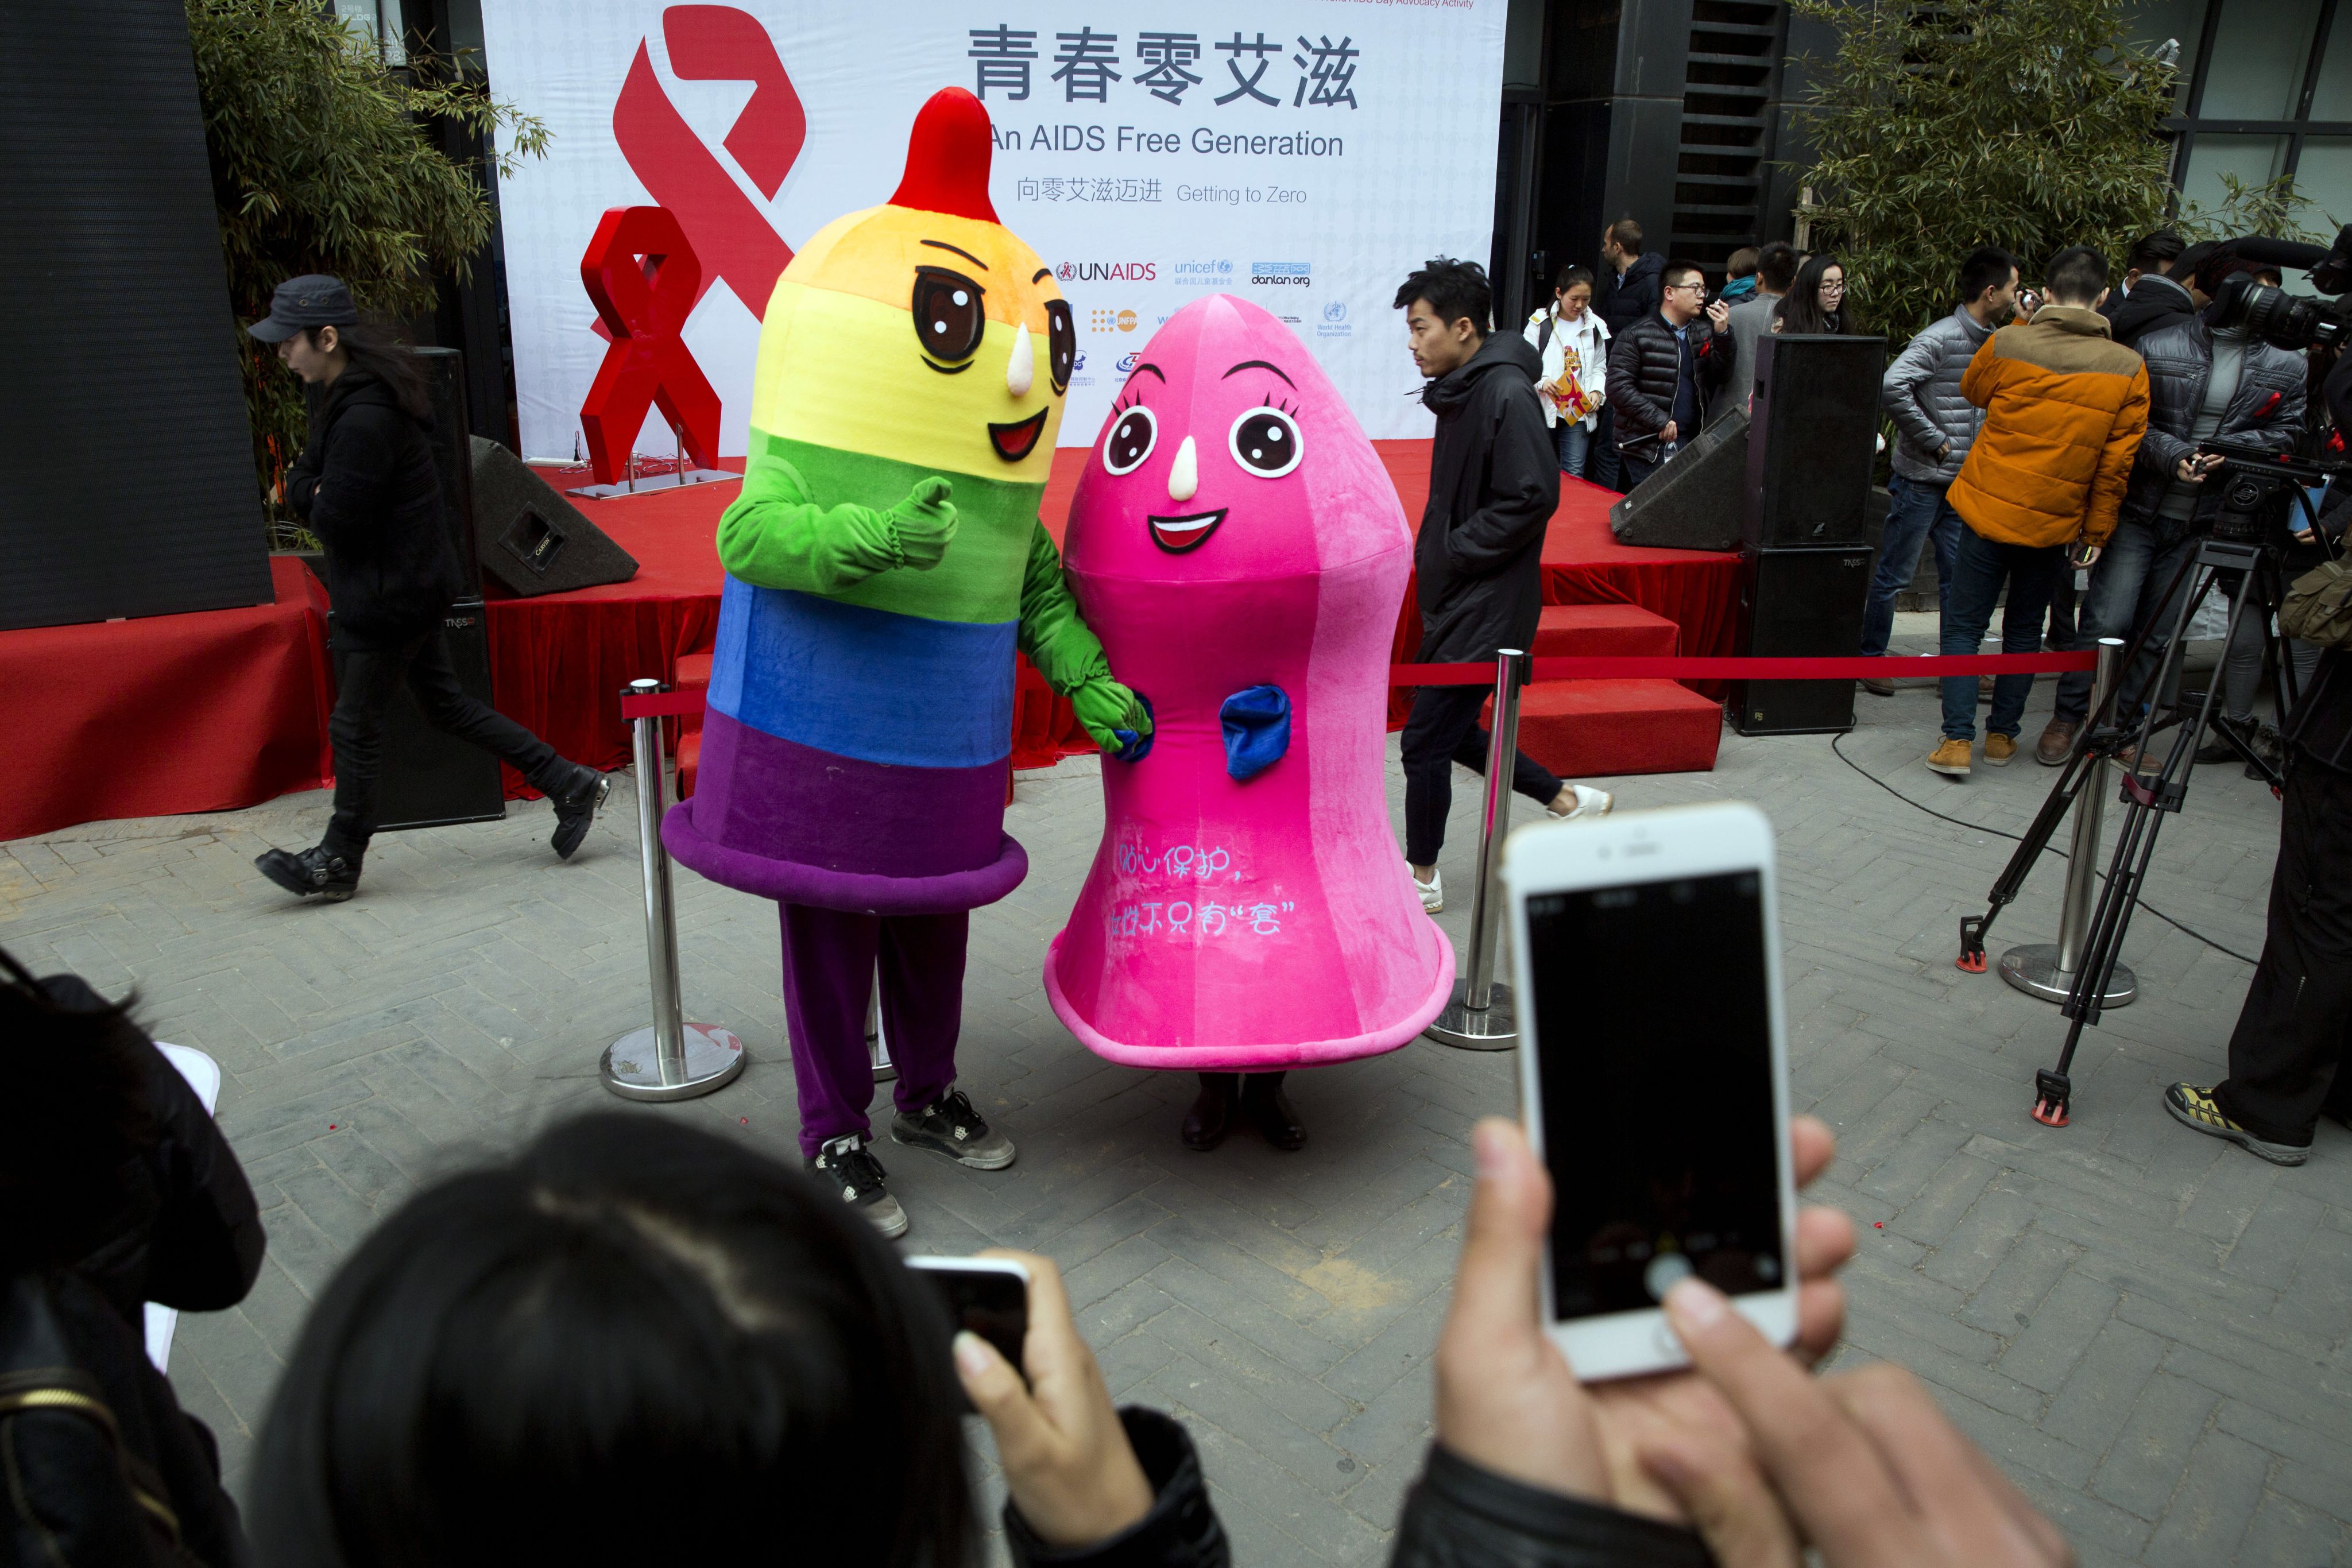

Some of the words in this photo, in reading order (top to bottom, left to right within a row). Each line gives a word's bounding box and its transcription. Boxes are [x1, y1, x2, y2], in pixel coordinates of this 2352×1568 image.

[1441, 0, 1474, 10] Activity
[968, 24, 1360, 110] 青春零艾滋
[991, 123, 1021, 150] An
[1030, 125, 1105, 152] AIDS
[1117, 126, 1181, 153] Free
[1192, 127, 1343, 156] Generation
[1018, 177, 1162, 202] 向零艾滋迈进
[1177, 185, 1239, 206] Getting
[1245, 186, 1261, 202] to
[1266, 186, 1307, 203] Zero
[1079, 263, 1156, 281] UNAIDS
[1175, 260, 1216, 273] unicef
[1175, 277, 1232, 285] 联合国儿童基金会
[1117, 317, 1138, 325] UNFPA
[535, 537, 550, 556] CARVIN
